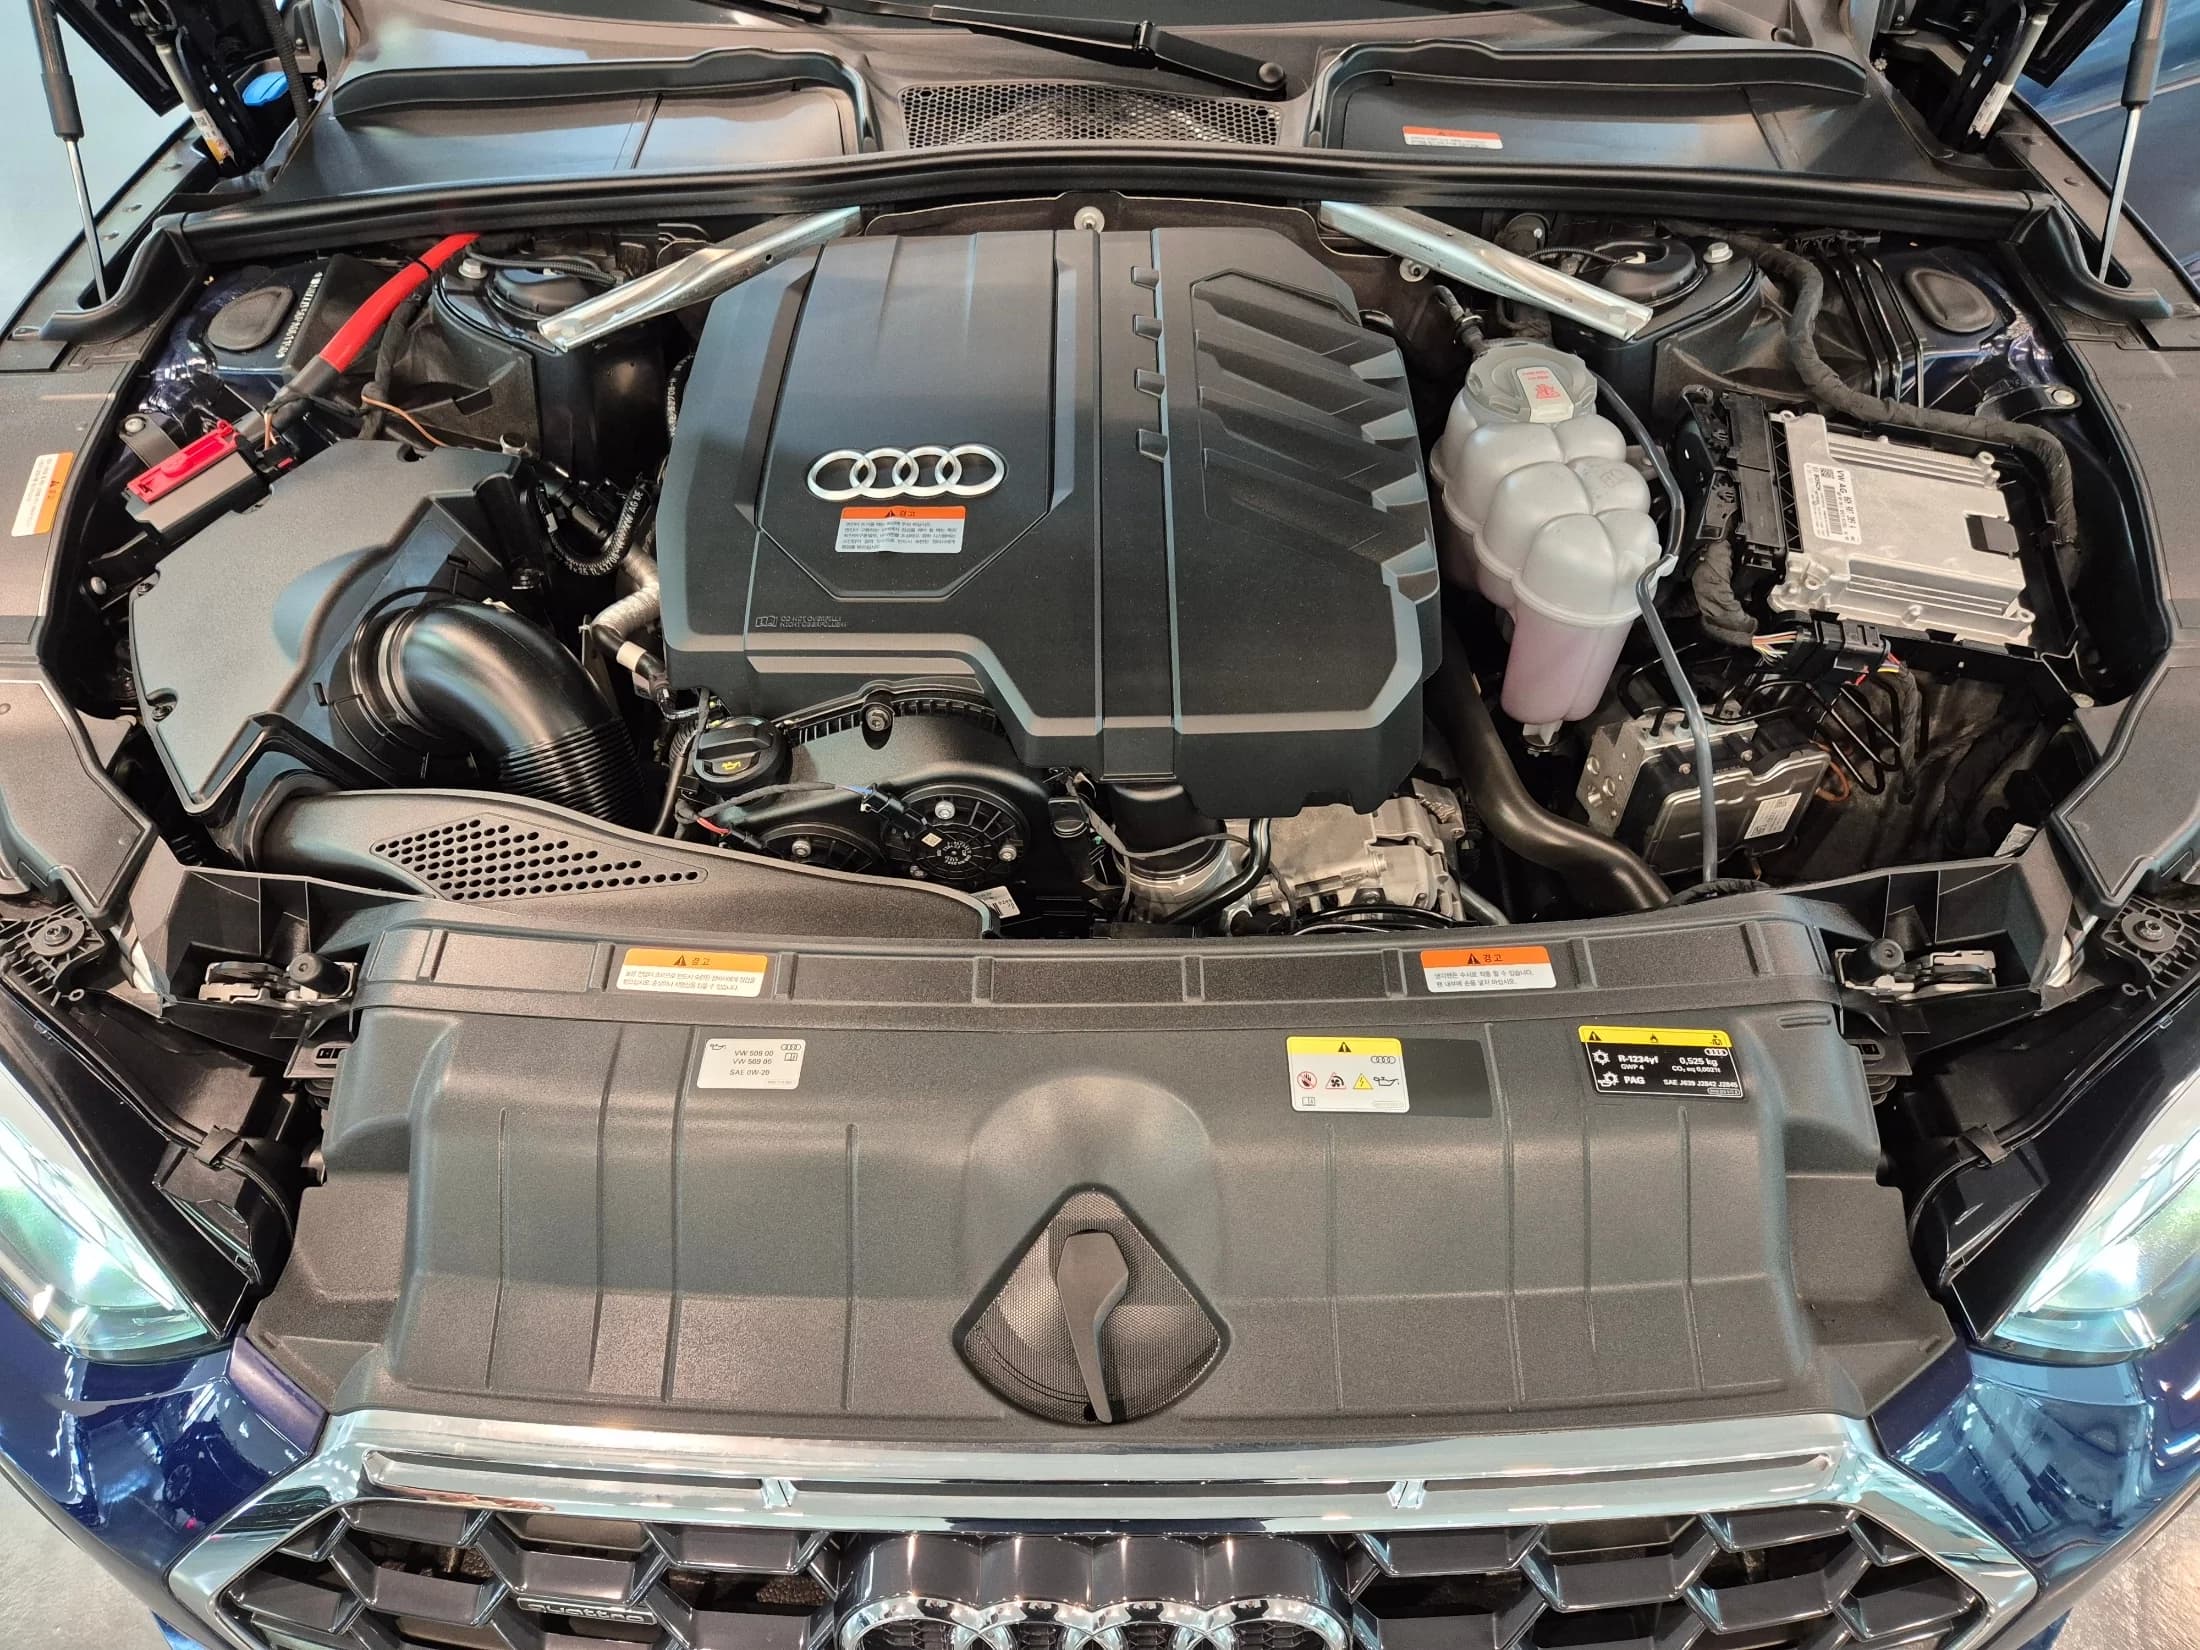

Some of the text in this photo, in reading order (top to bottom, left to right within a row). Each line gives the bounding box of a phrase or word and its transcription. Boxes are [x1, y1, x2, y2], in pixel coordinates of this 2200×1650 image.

[1678, 1056, 1719, 1067] 0,525 kg
[729, 1068, 770, 1076] SAE 0W-20
[1623, 1075, 1646, 1085] PAG
